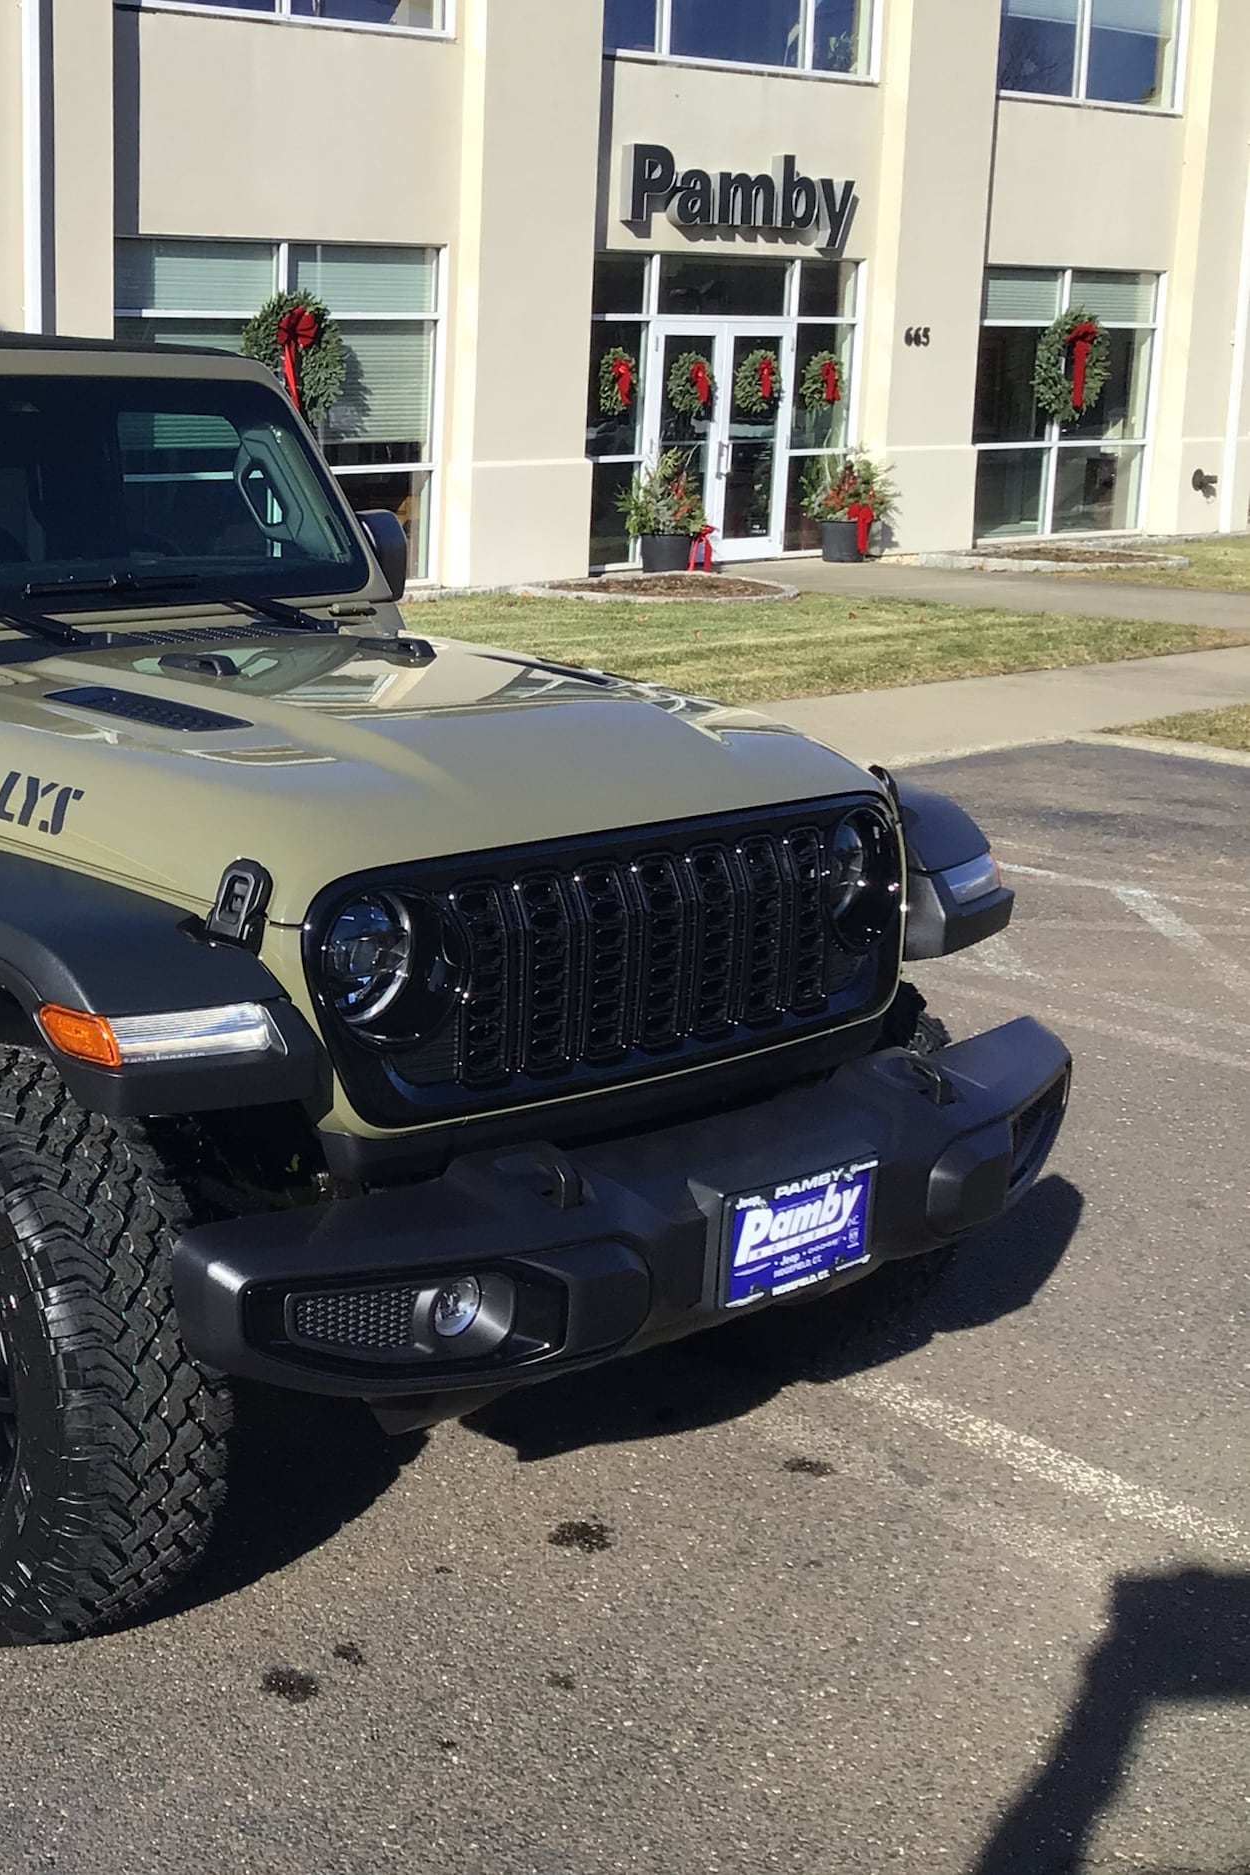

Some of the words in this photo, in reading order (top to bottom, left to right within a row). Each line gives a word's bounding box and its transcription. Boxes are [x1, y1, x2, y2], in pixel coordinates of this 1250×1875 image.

[622, 143, 856, 249] Pamby
[904, 326, 931, 347] 665
[774, 1168, 844, 1200] PAMBY
[734, 1183, 863, 1267] Pamby
